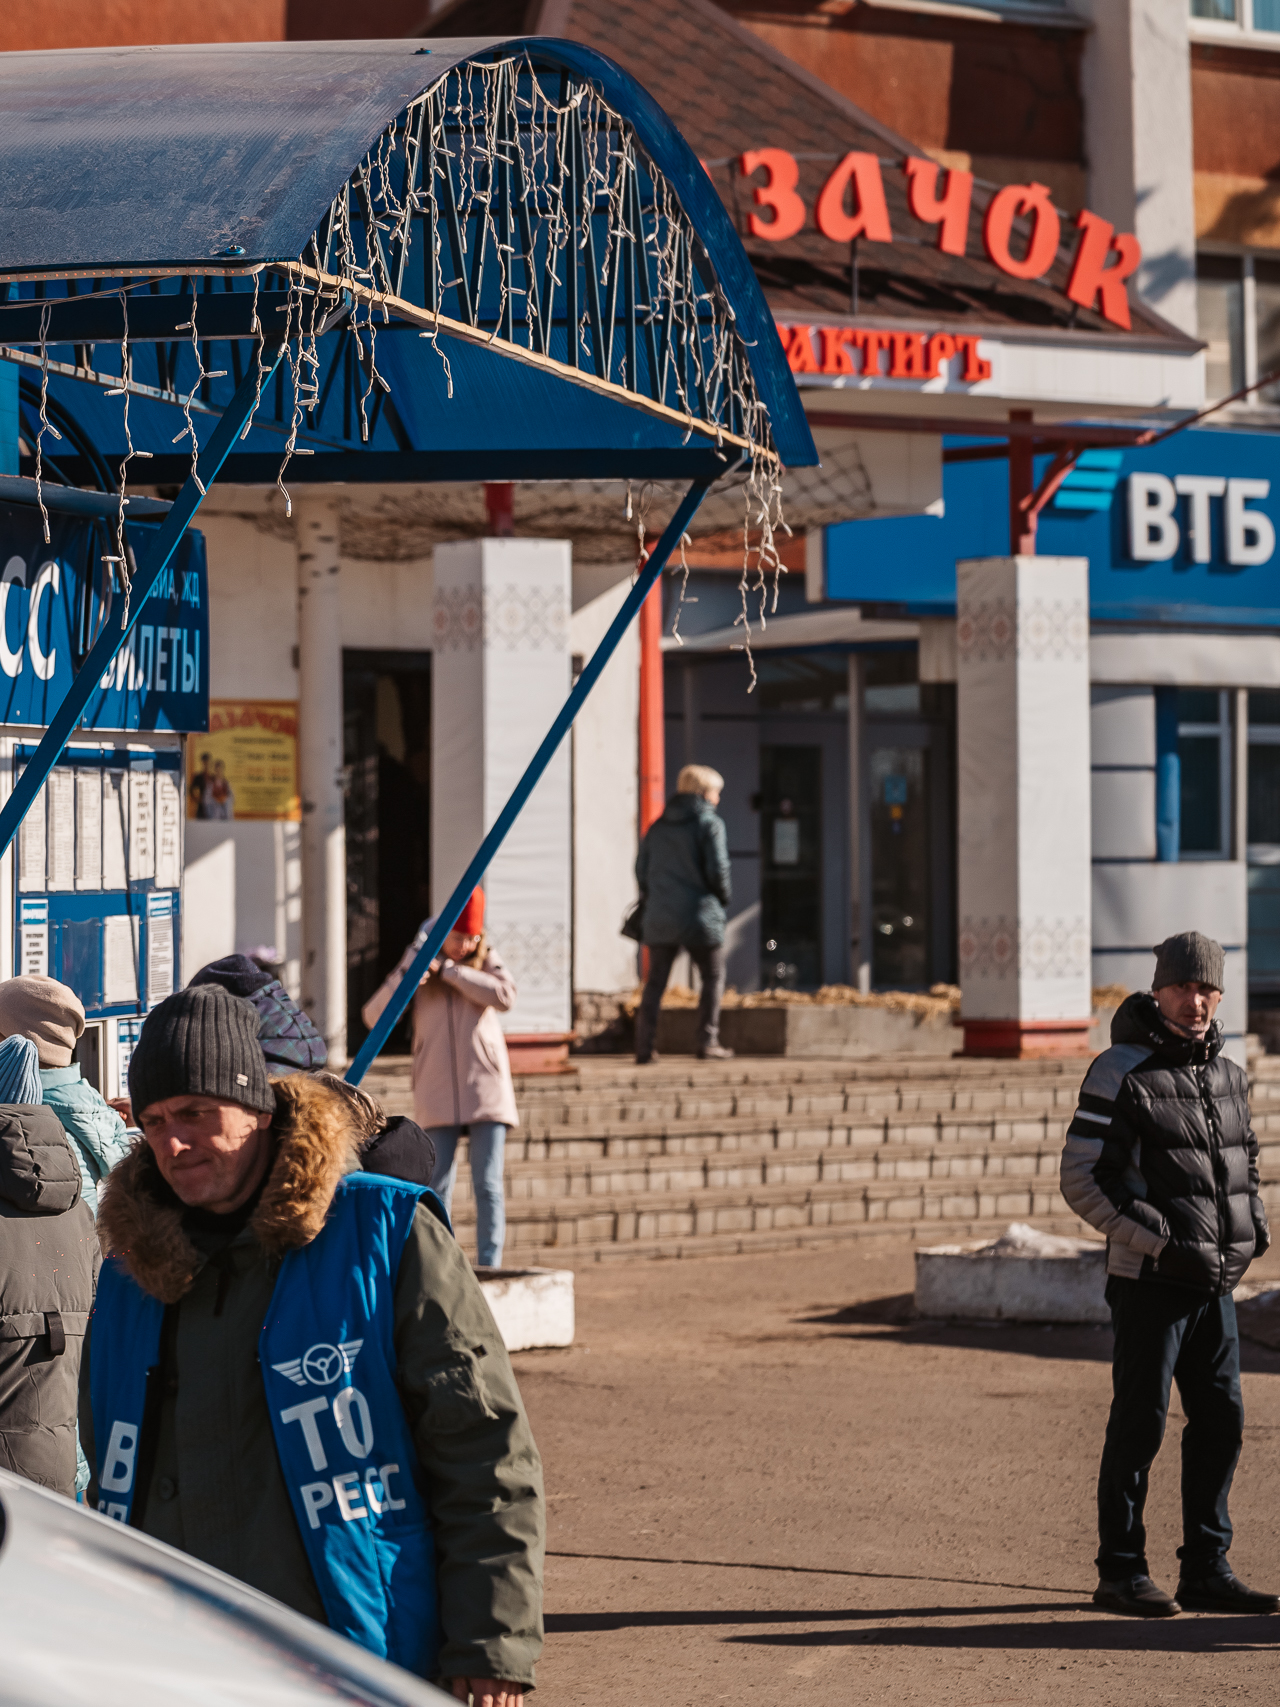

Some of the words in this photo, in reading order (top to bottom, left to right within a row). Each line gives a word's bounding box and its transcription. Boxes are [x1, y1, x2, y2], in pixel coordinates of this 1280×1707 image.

[700, 147, 1142, 330] ЗАЧОК
[1128, 471, 1277, 567] ВТБ
[181, 570, 201, 609] ЖД
[100, 1420, 138, 1494] В
[280, 1386, 374, 1472] ТО
[300, 1463, 406, 1529] РЕСС
